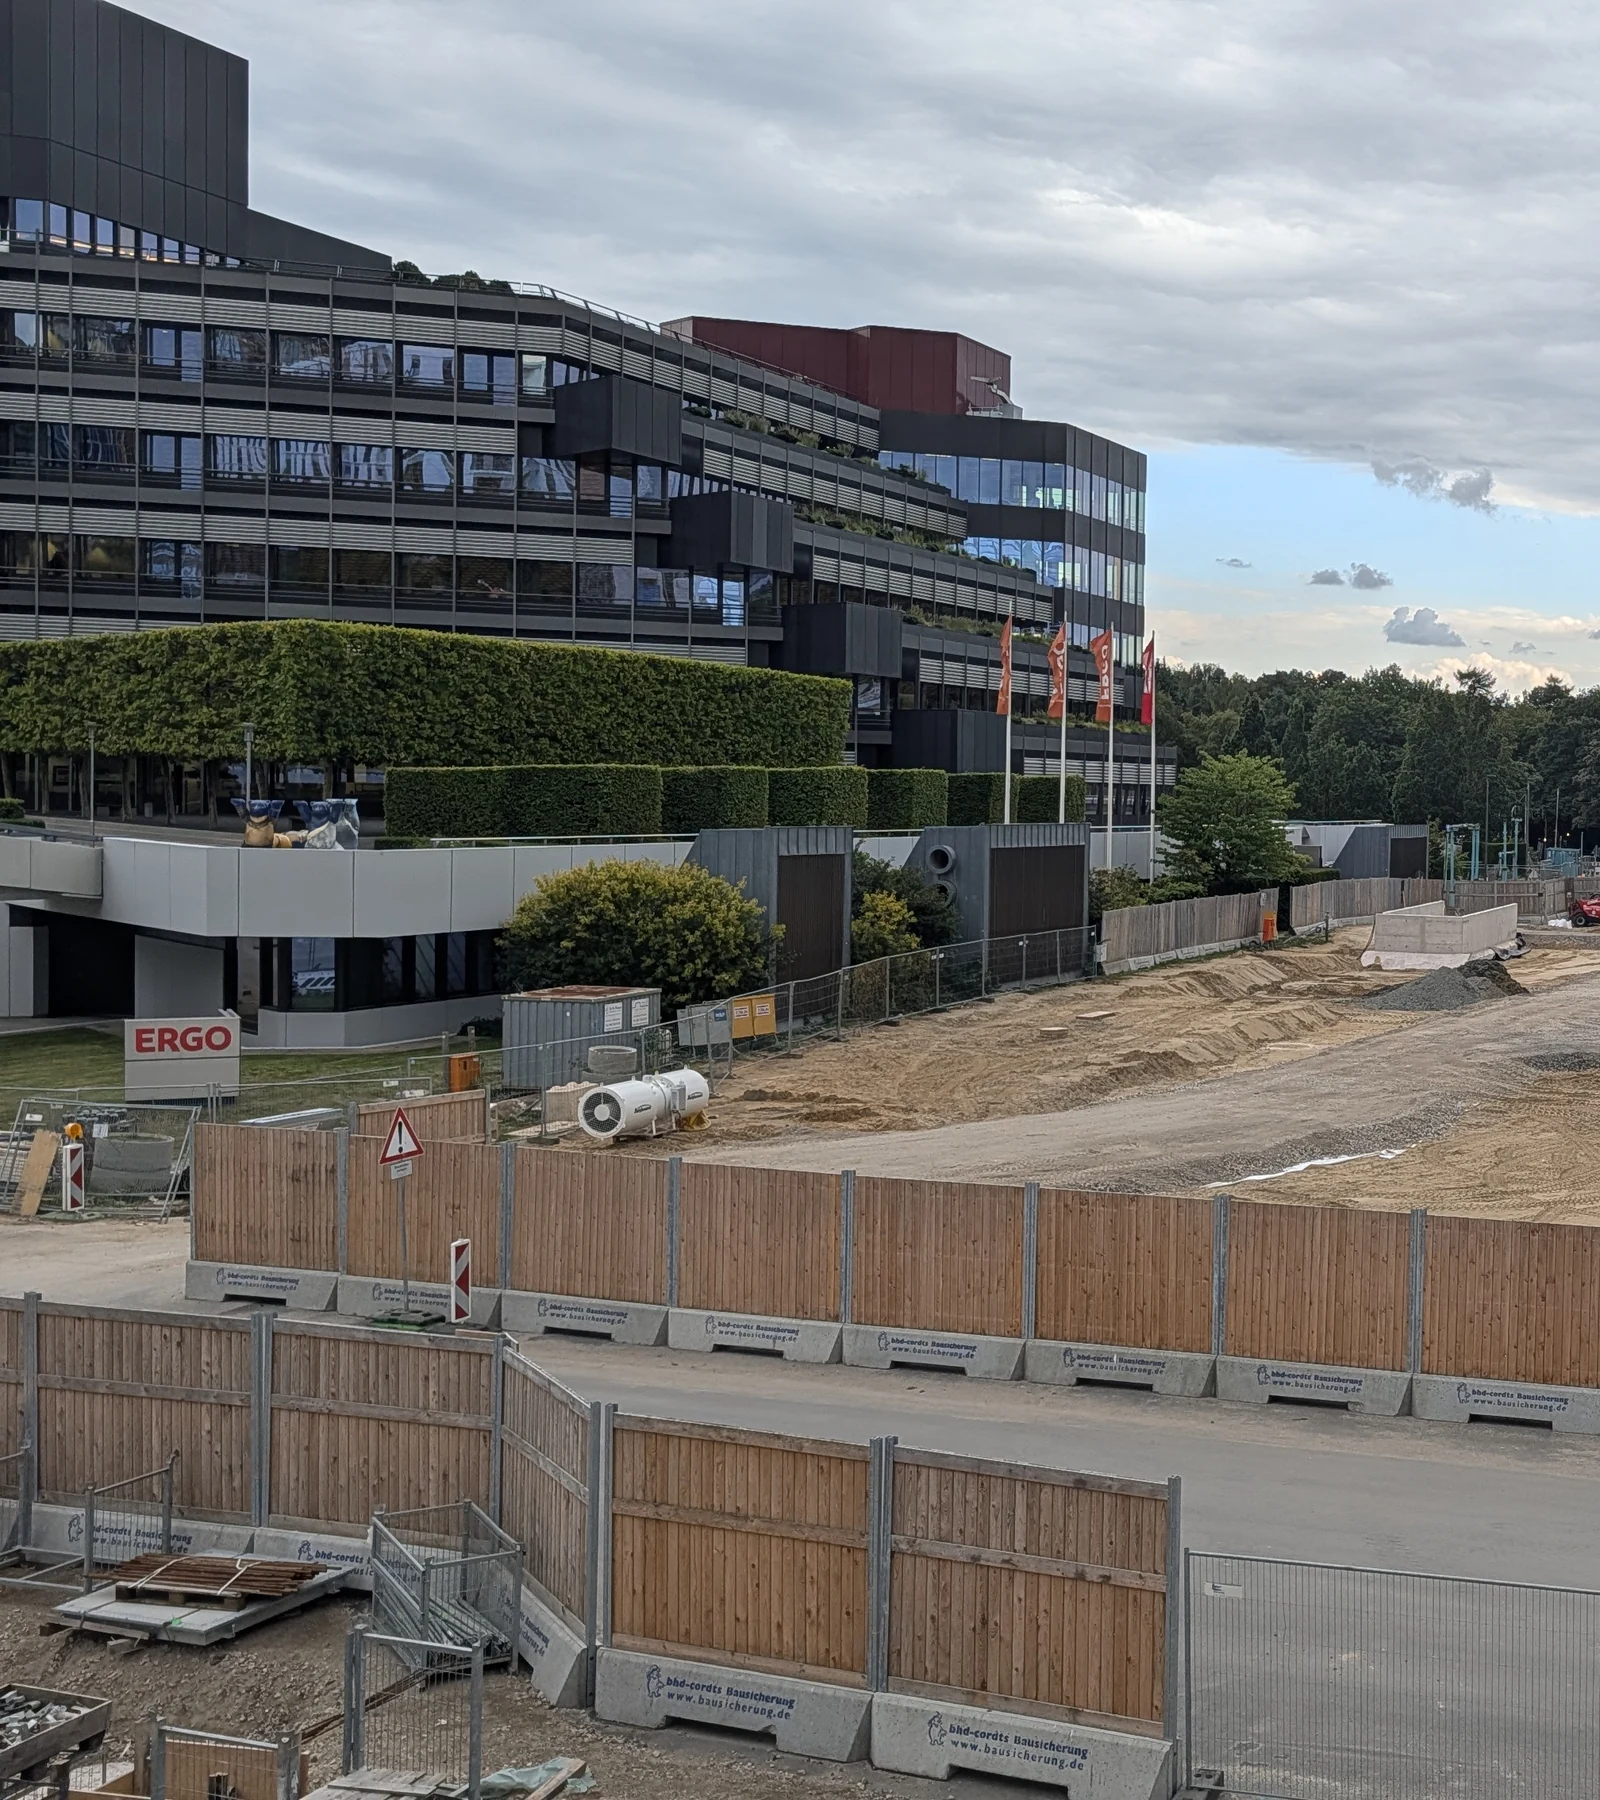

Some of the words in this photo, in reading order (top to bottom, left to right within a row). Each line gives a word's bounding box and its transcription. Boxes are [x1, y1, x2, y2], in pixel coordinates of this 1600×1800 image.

[136, 1026, 231, 1053] ERGO
[315, 1549, 364, 1563] bhd-cordts
[666, 1677, 722, 1694] bhd-cordts
[726, 1687, 795, 1709] Bausicherung
[667, 1691, 791, 1719] www.bausicherung.de
[949, 1724, 1009, 1742] bhd-cordts
[1014, 1736, 1088, 1759] Bausicherung
[951, 1739, 1084, 1770] www.bausicherung.de
